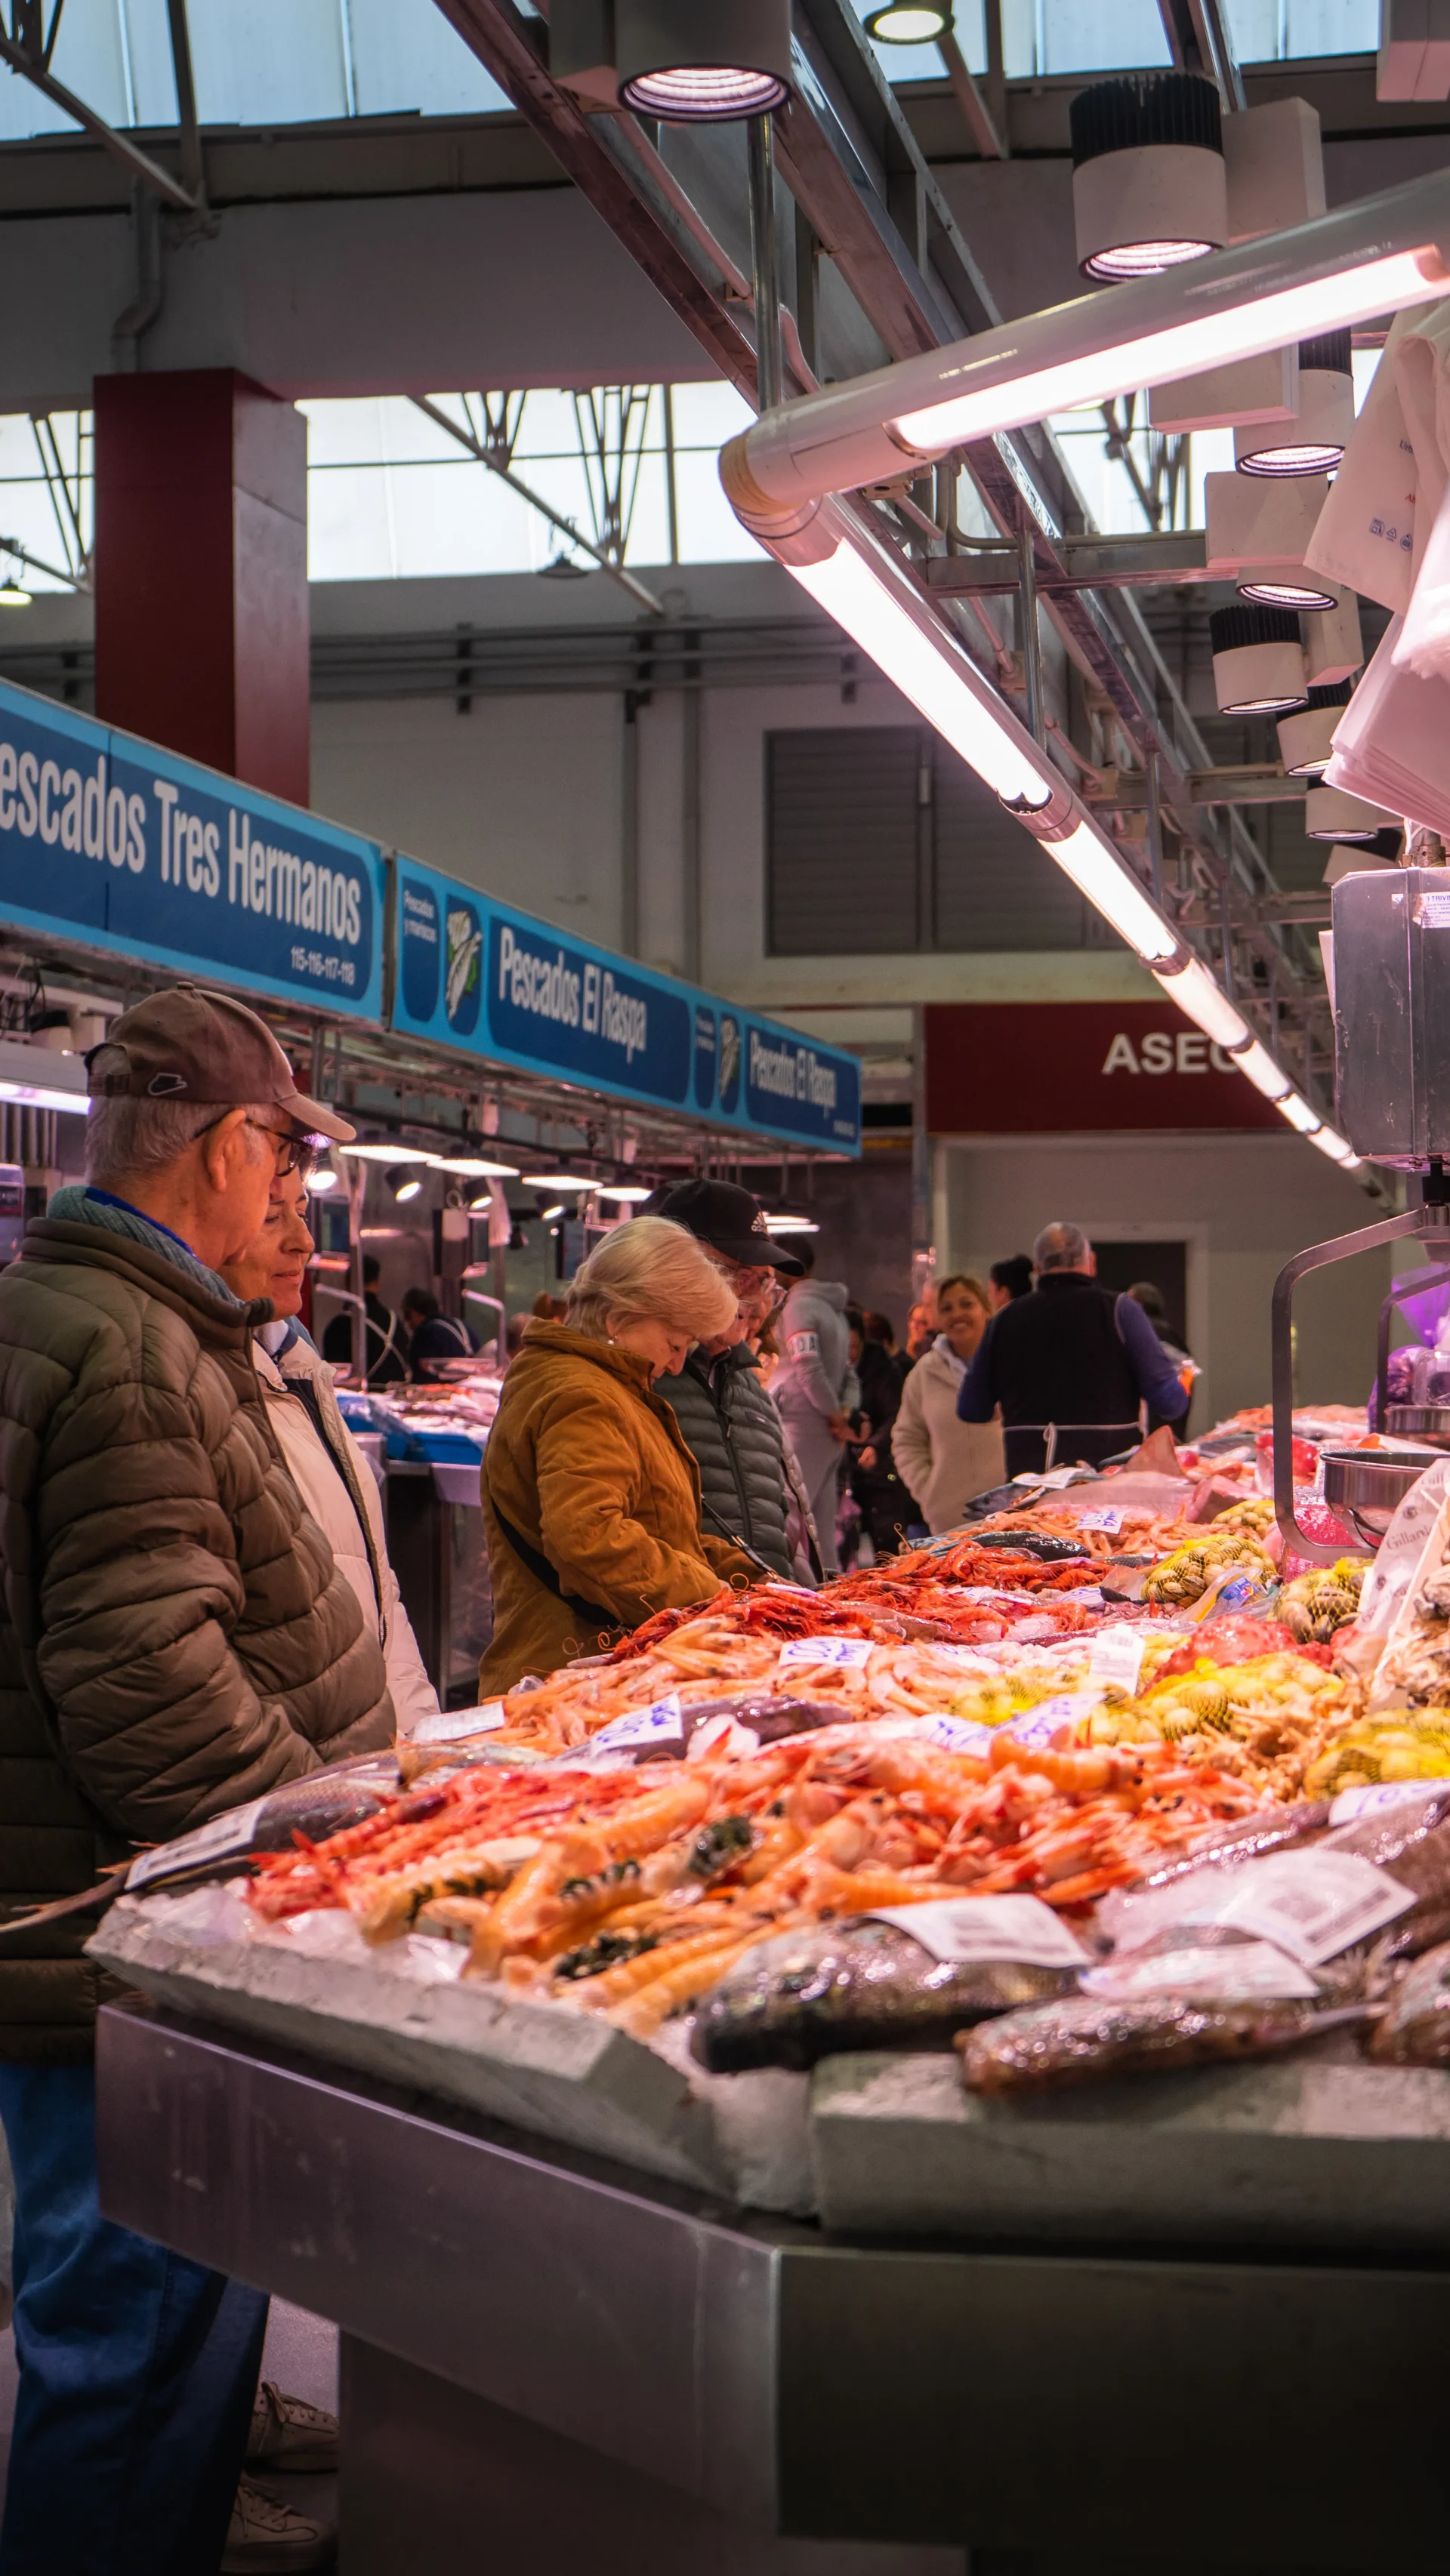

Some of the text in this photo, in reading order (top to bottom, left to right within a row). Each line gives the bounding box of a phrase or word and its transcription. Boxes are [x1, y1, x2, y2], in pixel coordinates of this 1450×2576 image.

[154, 778, 220, 898] Tres
[229, 808, 361, 945] Hermanos
[498, 926, 647, 1065] Pescados El Raspa
